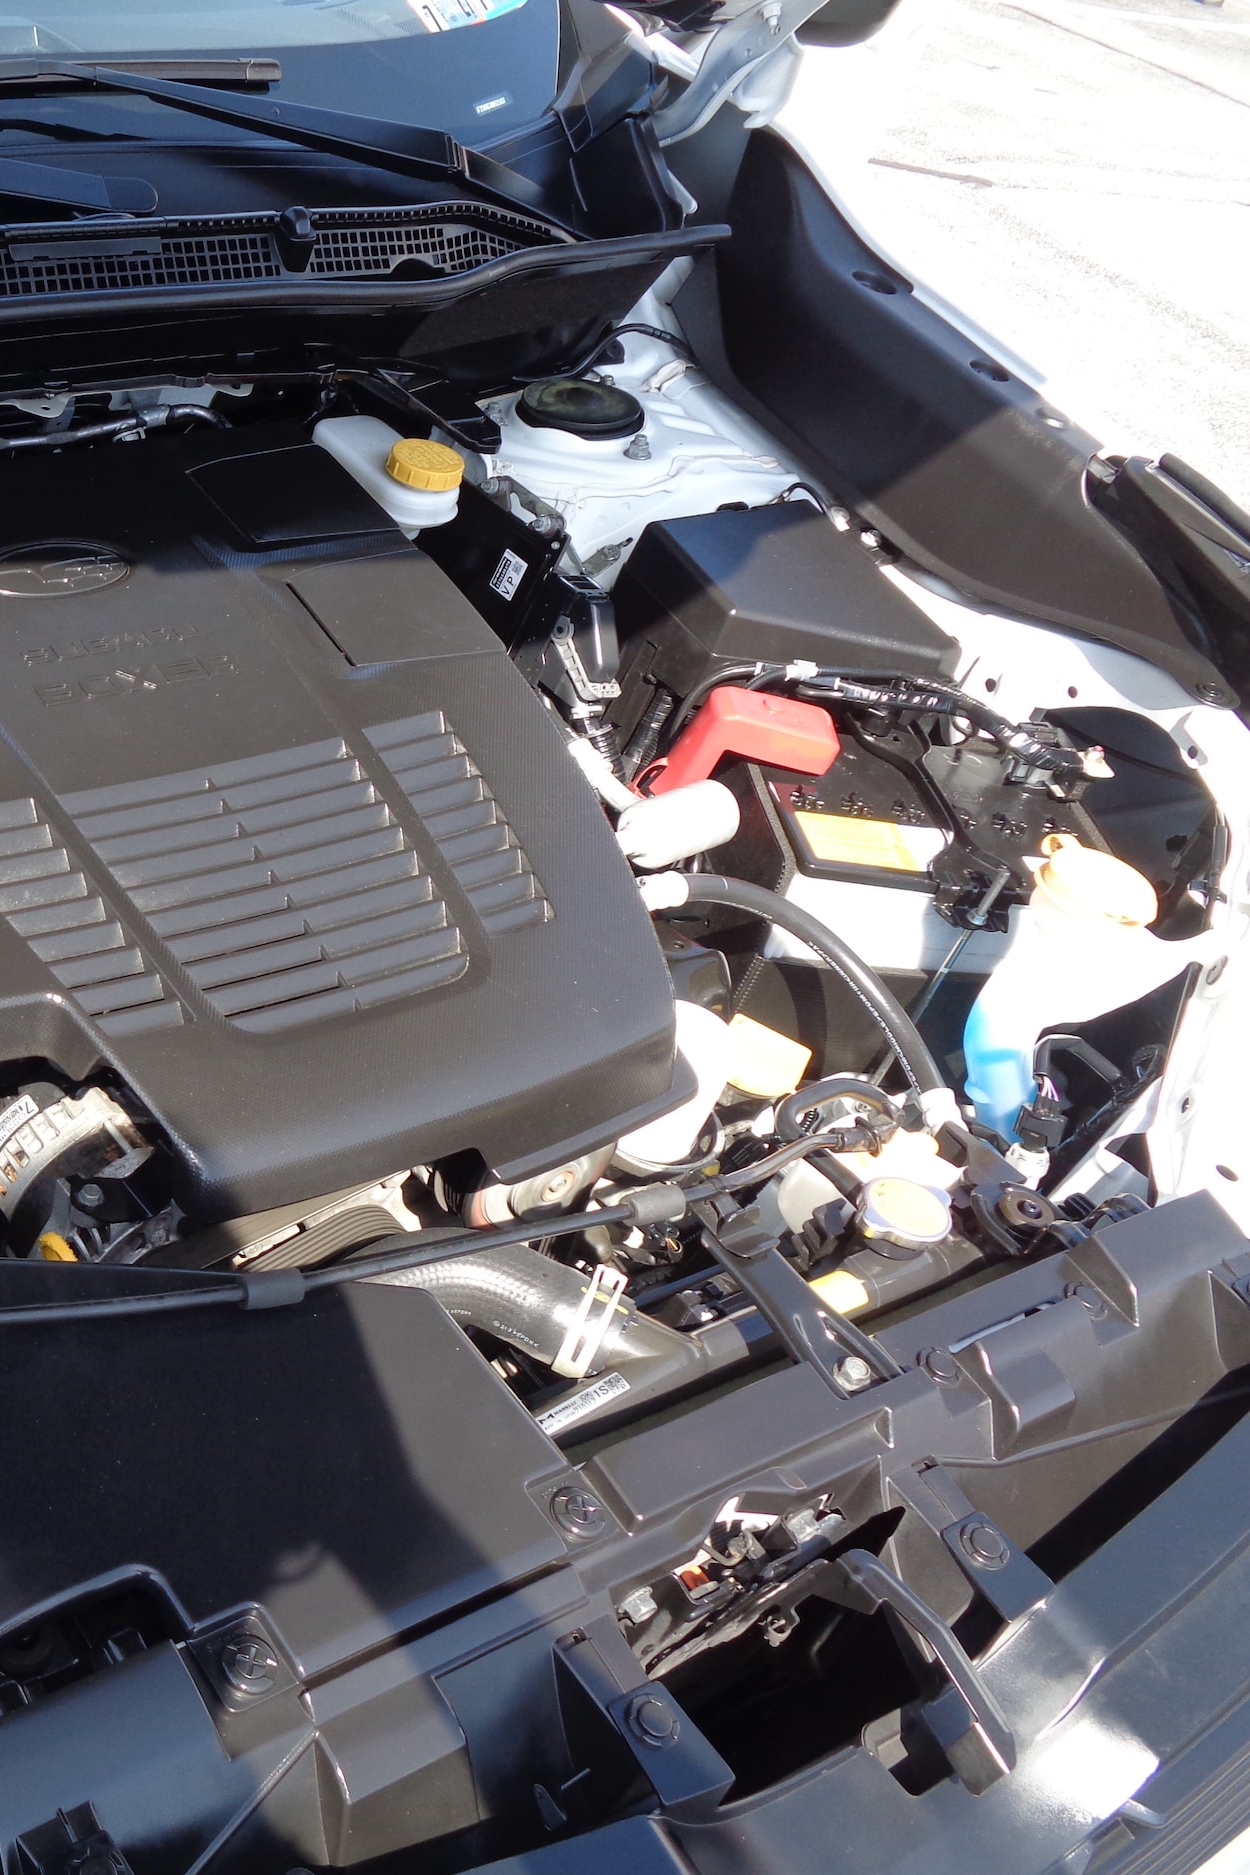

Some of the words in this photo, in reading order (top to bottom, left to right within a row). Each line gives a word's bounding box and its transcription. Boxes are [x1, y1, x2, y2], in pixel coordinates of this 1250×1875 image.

[20, 622, 199, 666] SUBARU
[32, 655, 240, 708] BOXER
[592, 1384, 610, 1398] 1S
